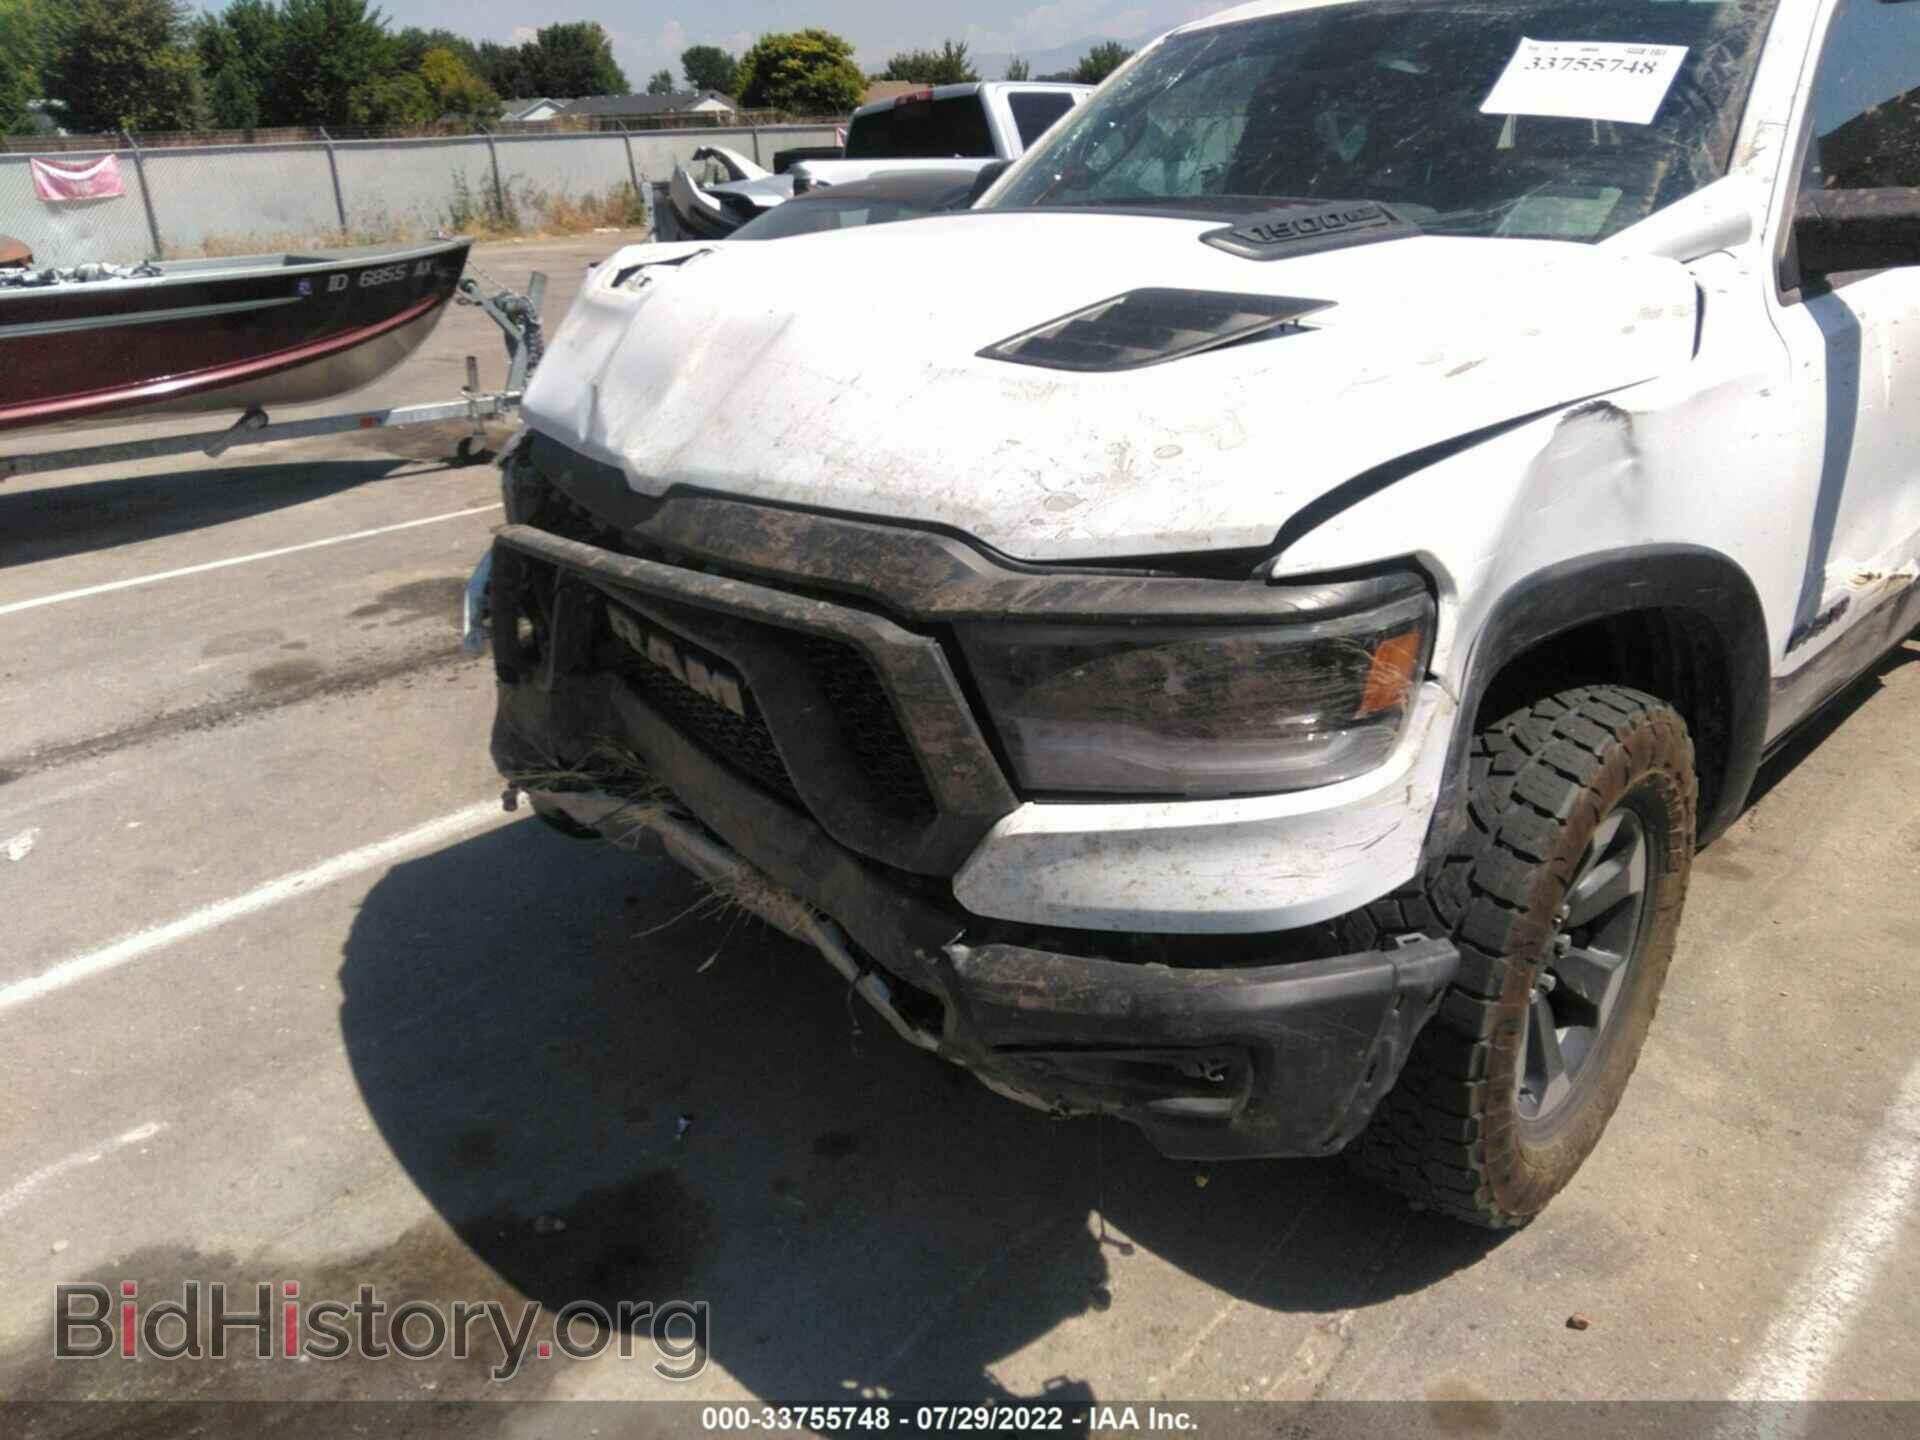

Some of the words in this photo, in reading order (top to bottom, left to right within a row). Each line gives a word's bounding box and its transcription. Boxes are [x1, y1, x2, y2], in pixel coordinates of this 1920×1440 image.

[1523, 56, 1657, 74] 33755748
[1252, 208, 1347, 241] 1500
[327, 273, 348, 292] ID
